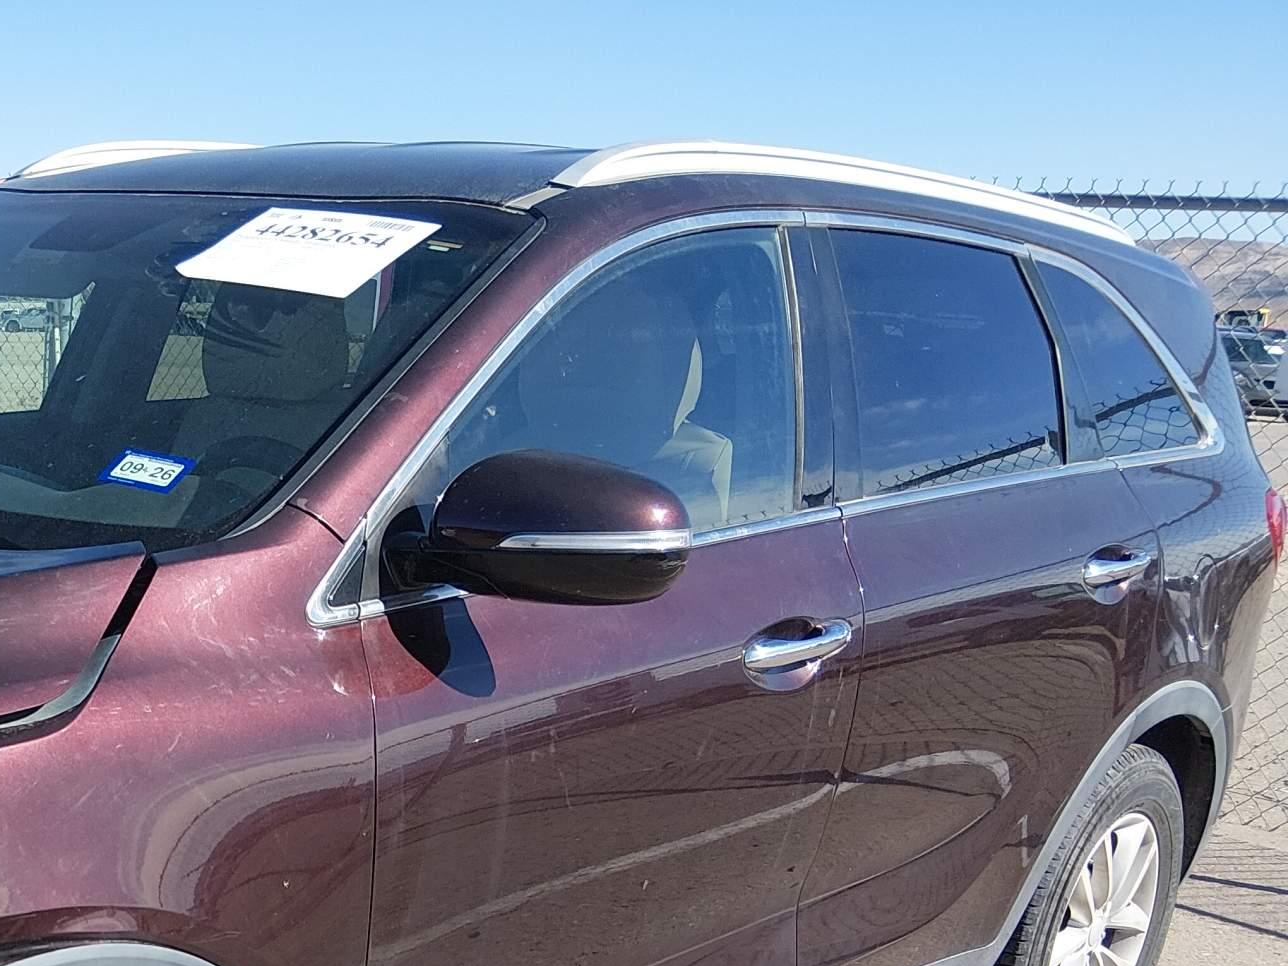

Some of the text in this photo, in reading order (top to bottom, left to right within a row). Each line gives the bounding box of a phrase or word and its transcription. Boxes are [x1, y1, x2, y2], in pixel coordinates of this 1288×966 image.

[256, 223, 394, 248] 44282654
[120, 461, 145, 474] 09
[149, 467, 176, 480] 26
